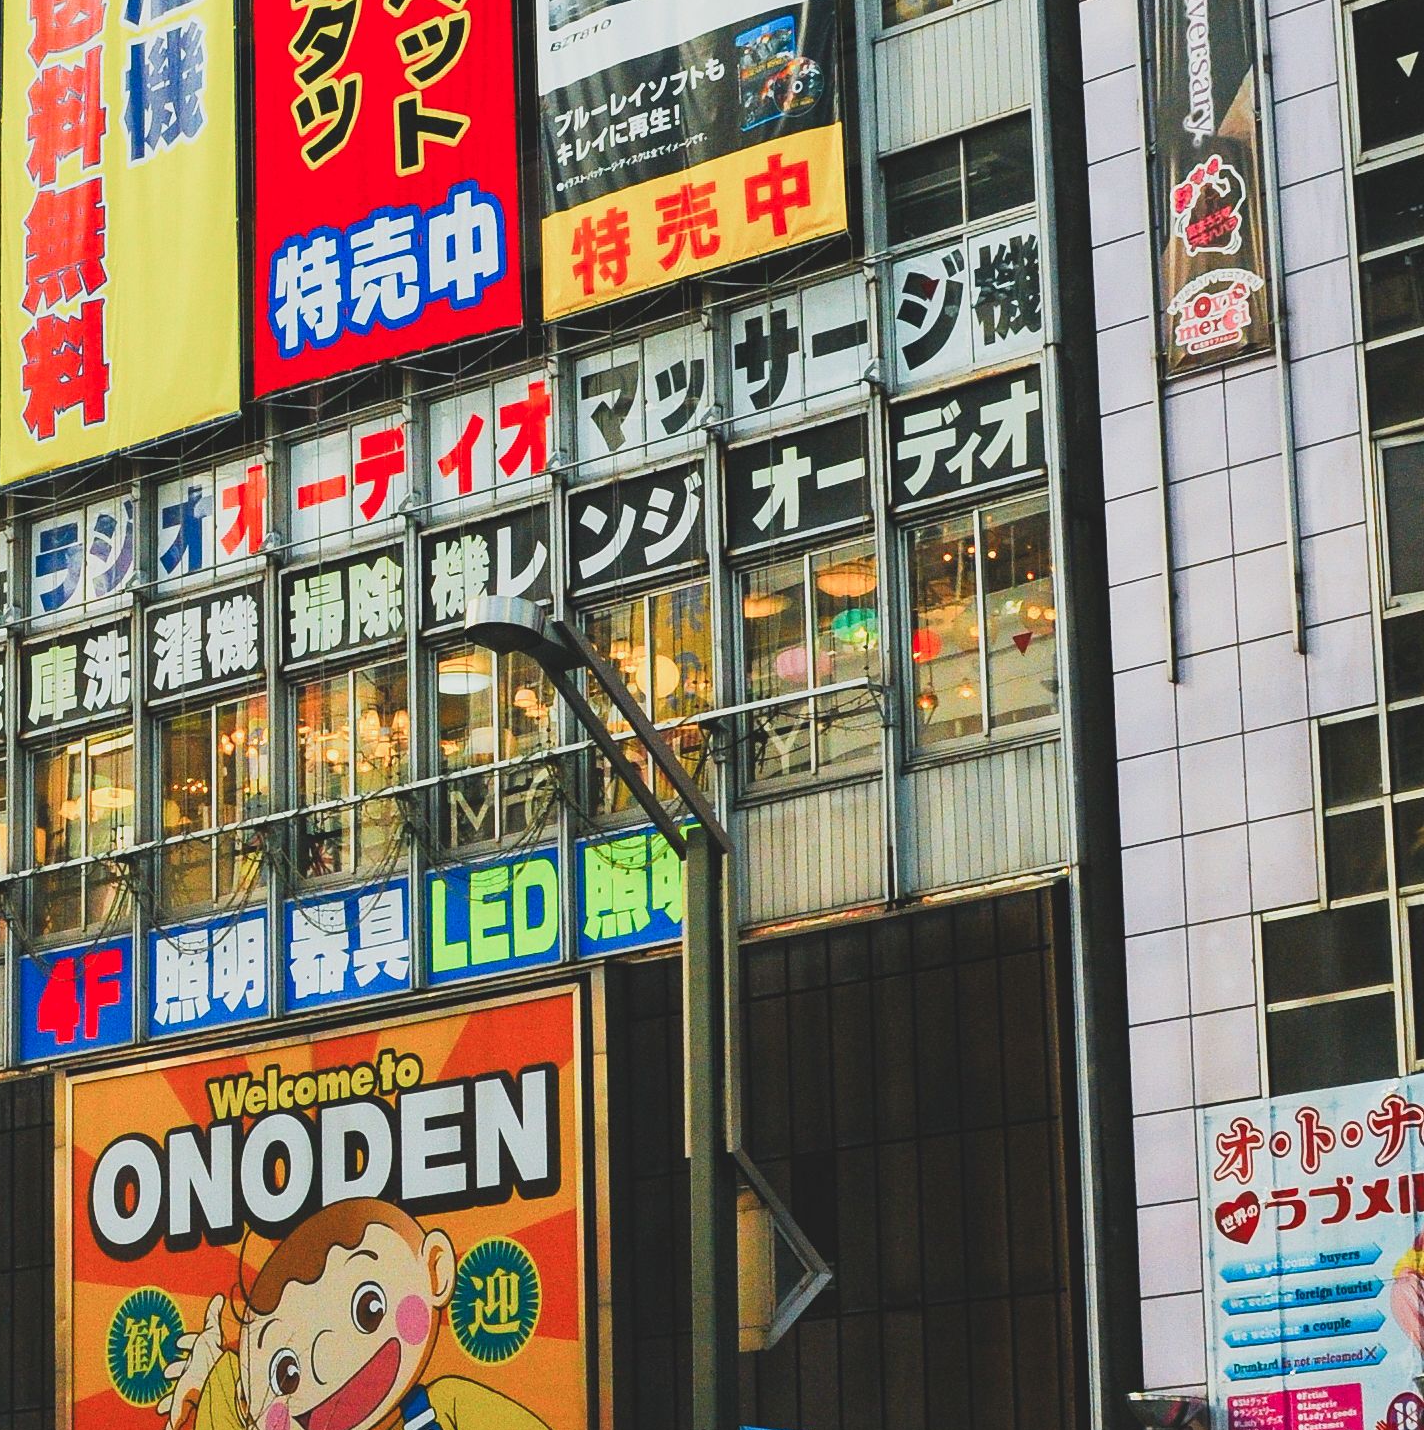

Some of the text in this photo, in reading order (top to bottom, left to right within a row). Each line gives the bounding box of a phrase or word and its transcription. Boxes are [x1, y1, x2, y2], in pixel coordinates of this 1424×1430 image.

[553, 57, 726, 139] ブルーレイソフトも
[555, 103, 682, 168] キレイに再生!
[570, 152, 811, 297] 特売中
[269, 180, 507, 360] 特売中
[34, 233, 1044, 614] ラジオ オーディオ マッサージ機
[751, 379, 1041, 534] オーディオ
[36, 947, 125, 1046] 4F
[208, 1048, 422, 1122] Welcome to
[90, 1068, 552, 1247] ONODEN
[1215, 1094, 1424, 1185] オ・ト・ナ
[1220, 1204, 1259, 1234] 世界の
[1319, 1250, 1361, 1265] buyers
[467, 1266, 524, 1338] 迎
[1295, 1281, 1373, 1303] foreign tourist
[1312, 1317, 1352, 1334] couple
[1294, 1355, 1311, 1368] not
[1313, 1349, 1364, 1365] welcomed
